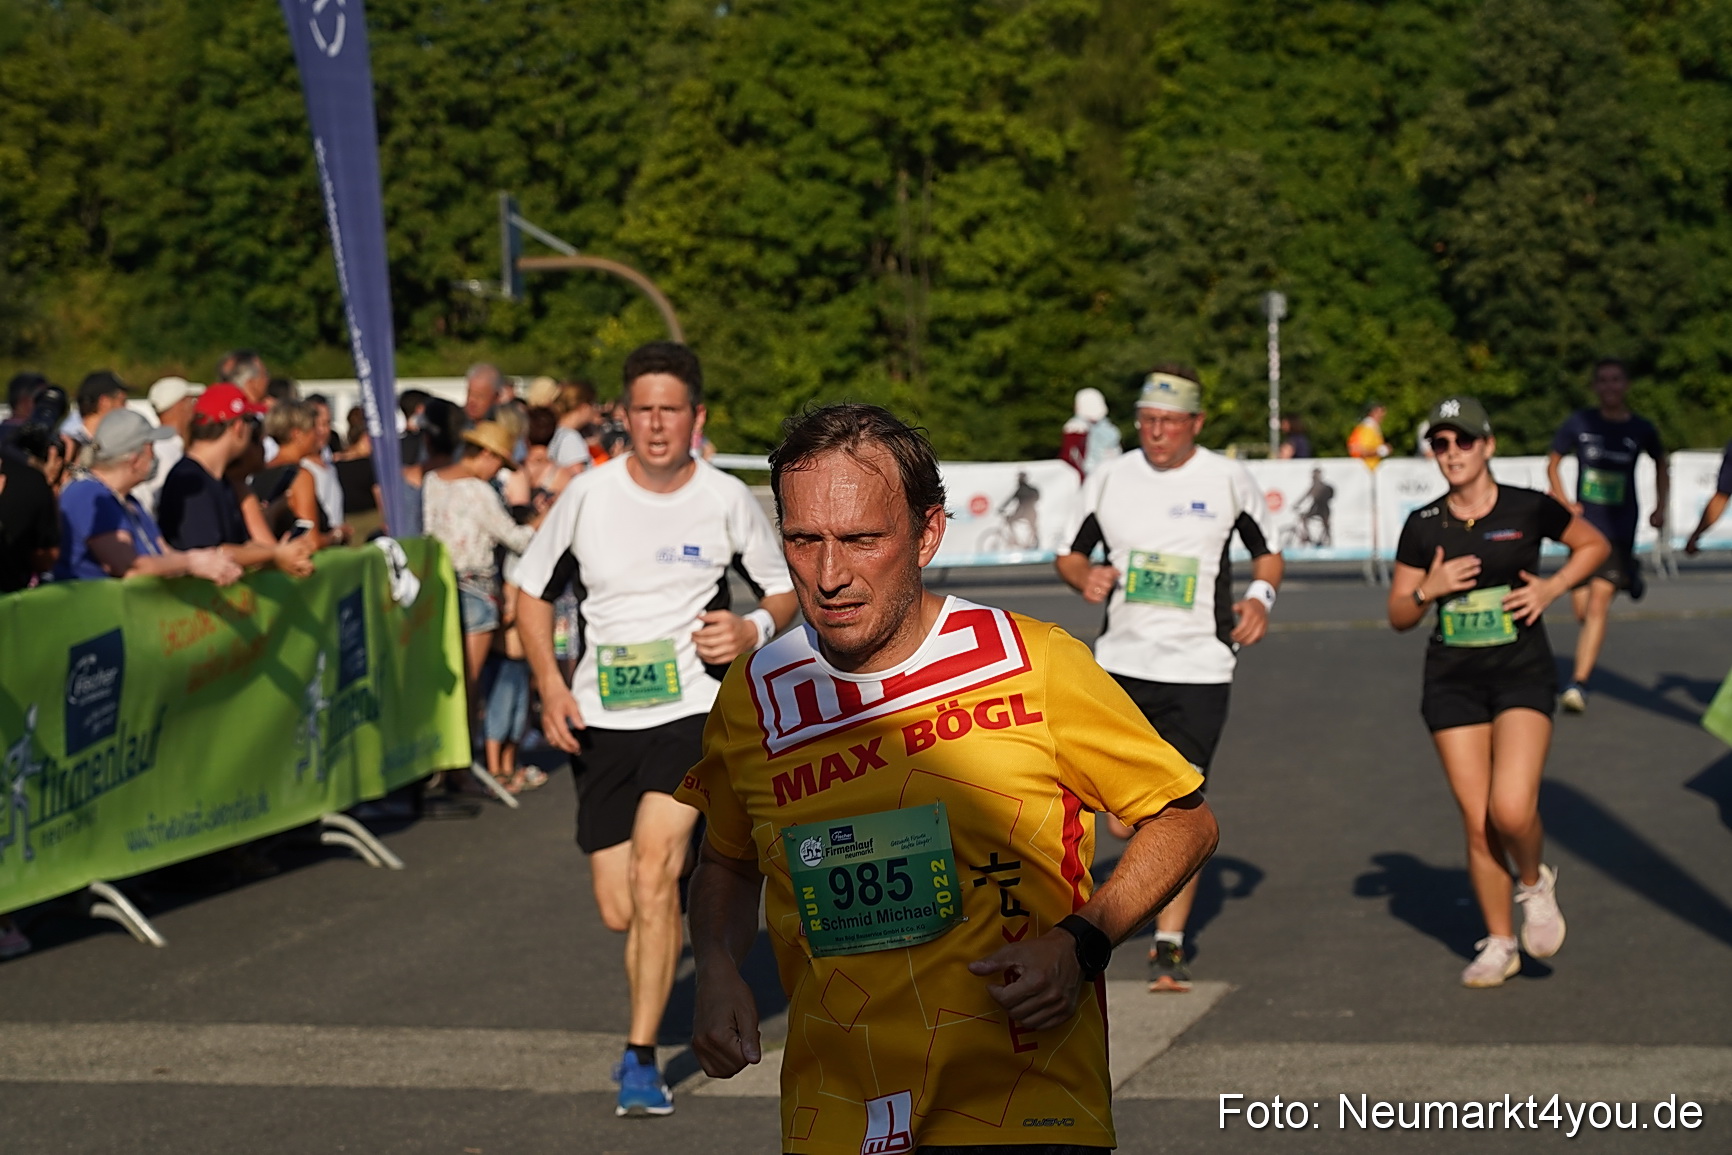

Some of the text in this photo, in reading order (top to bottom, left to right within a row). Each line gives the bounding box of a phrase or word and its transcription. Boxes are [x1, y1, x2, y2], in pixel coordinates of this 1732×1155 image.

[1458, 610, 1497, 628] 773
[614, 664, 657, 687] 524
[771, 693, 1044, 808] MAX BÖGL
[825, 838, 874, 858] Firmenlauf
[844, 847, 874, 859] neumarkt
[828, 857, 913, 910] 985
[930, 858, 954, 919] 2022
[802, 886, 822, 932] RUN
[821, 902, 938, 932] Schmid Michael
